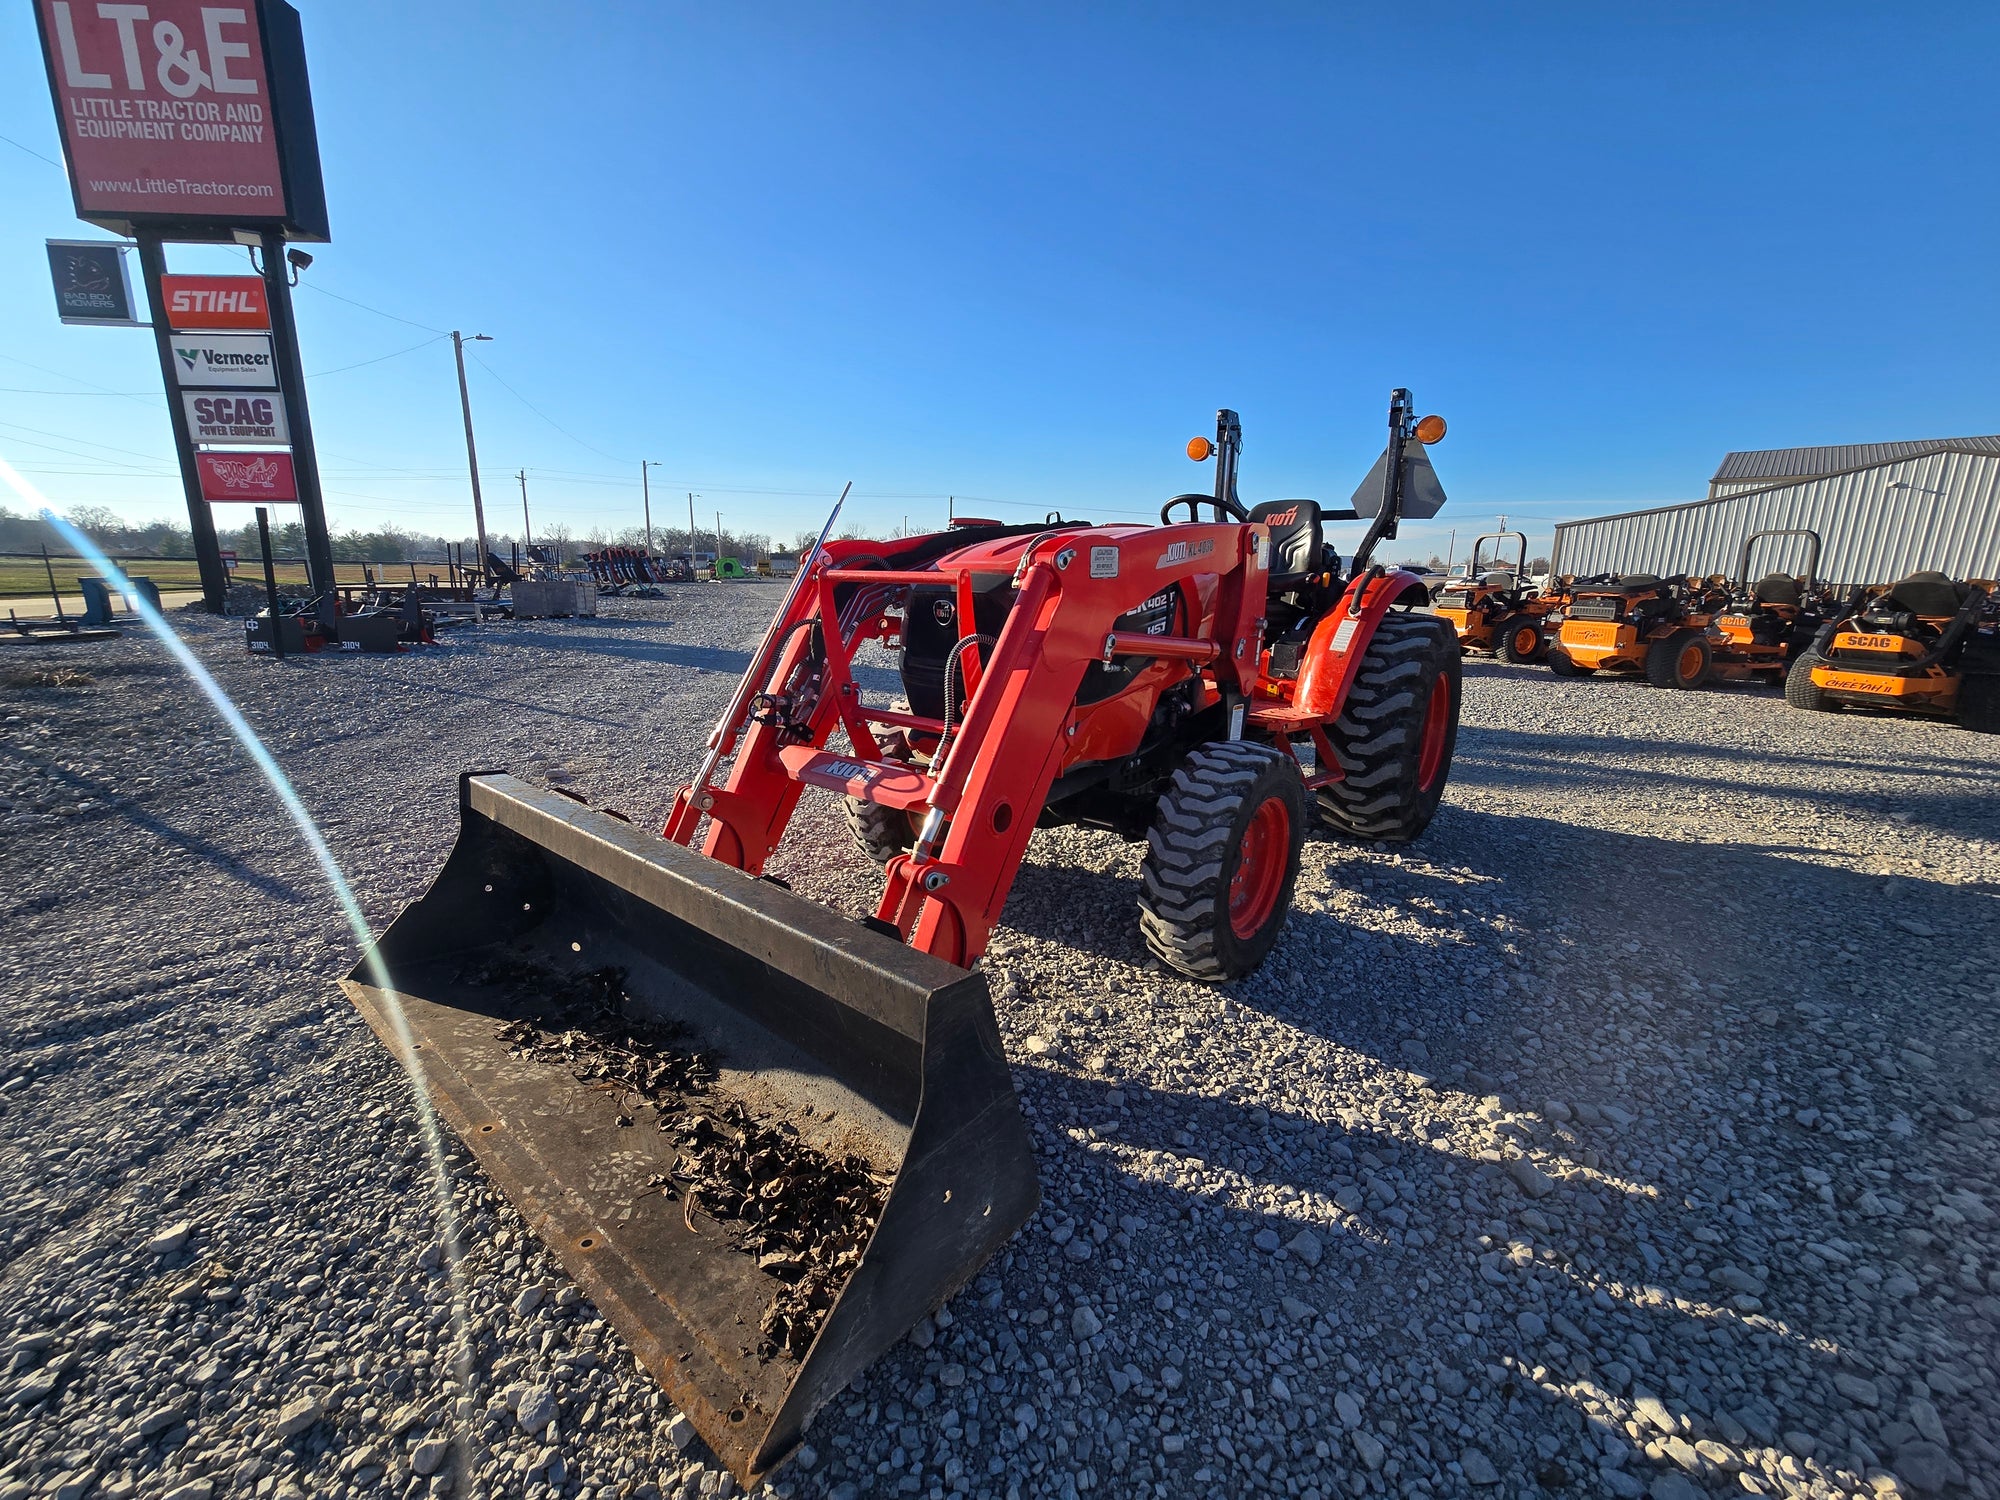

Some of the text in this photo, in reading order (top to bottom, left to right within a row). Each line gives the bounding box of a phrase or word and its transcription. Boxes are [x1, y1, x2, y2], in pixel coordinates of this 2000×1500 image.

[52, 0, 259, 98] LT&E
[70, 97, 263, 123] LITTLE TRACTOR AND
[75, 119, 264, 143] EQUIPMENT COMPANY
[89, 178, 274, 197] www.LittleTractor.com
[63, 292, 113, 301] BAD BOY
[65, 299, 116, 308] MOWERS
[171, 290, 257, 313] STIHL
[202, 349, 270, 366] Vermeer
[194, 397, 274, 426] SCAG
[199, 425, 276, 437] POWER EQUIPMENT
[1264, 505, 1298, 526] KIOTI
[1167, 541, 1187, 561] KIOTI
[1720, 616, 1747, 626] SCAG
[251, 641, 269, 649] 3104
[342, 641, 360, 649] 3104
[1847, 635, 1891, 648] SCAG
[1825, 679, 1882, 692] CHEETAH
[826, 760, 878, 783] KIOTI
